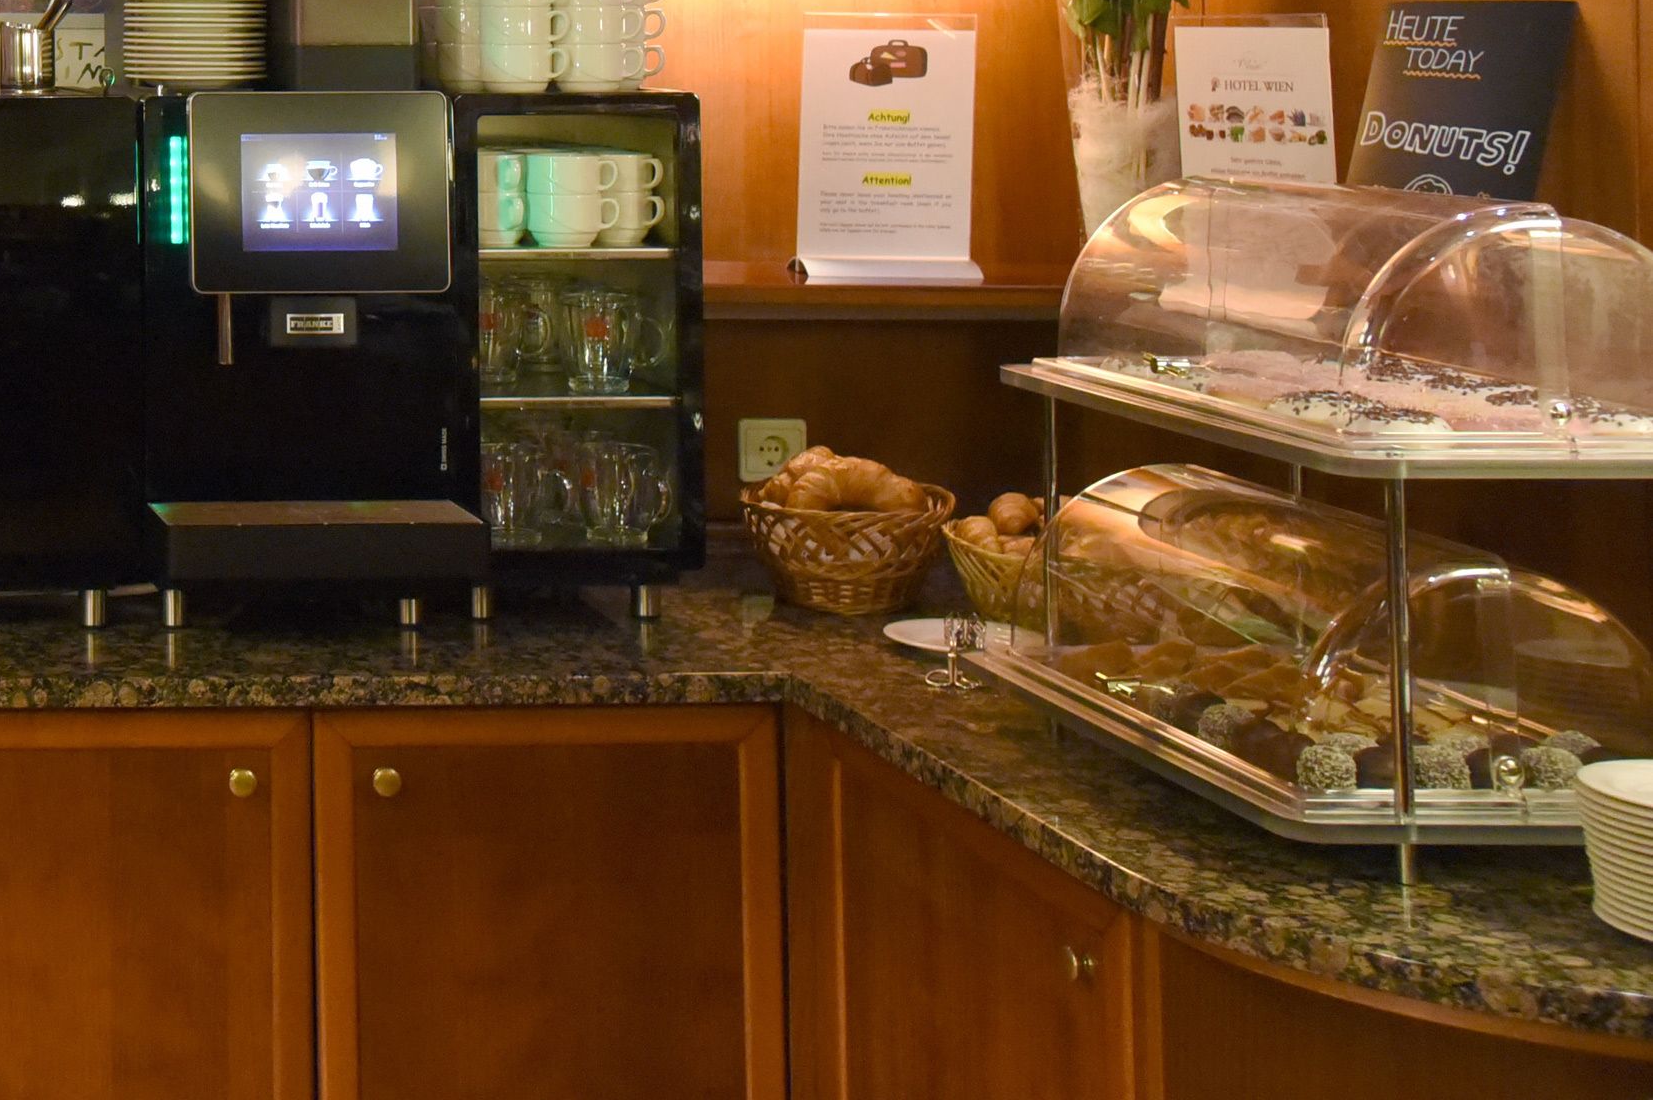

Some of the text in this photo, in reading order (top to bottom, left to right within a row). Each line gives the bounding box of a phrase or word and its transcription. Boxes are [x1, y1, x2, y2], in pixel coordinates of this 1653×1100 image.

[1386, 10, 1465, 42] HEUTE
[1405, 46, 1484, 72] TODAY
[1224, 80, 1294, 93] HOTEL WIEN
[867, 112, 910, 124] Achtung!
[1360, 111, 1531, 175] DONUTS!
[862, 175, 912, 186] Attention!
[290, 320, 332, 328] FRANKE
